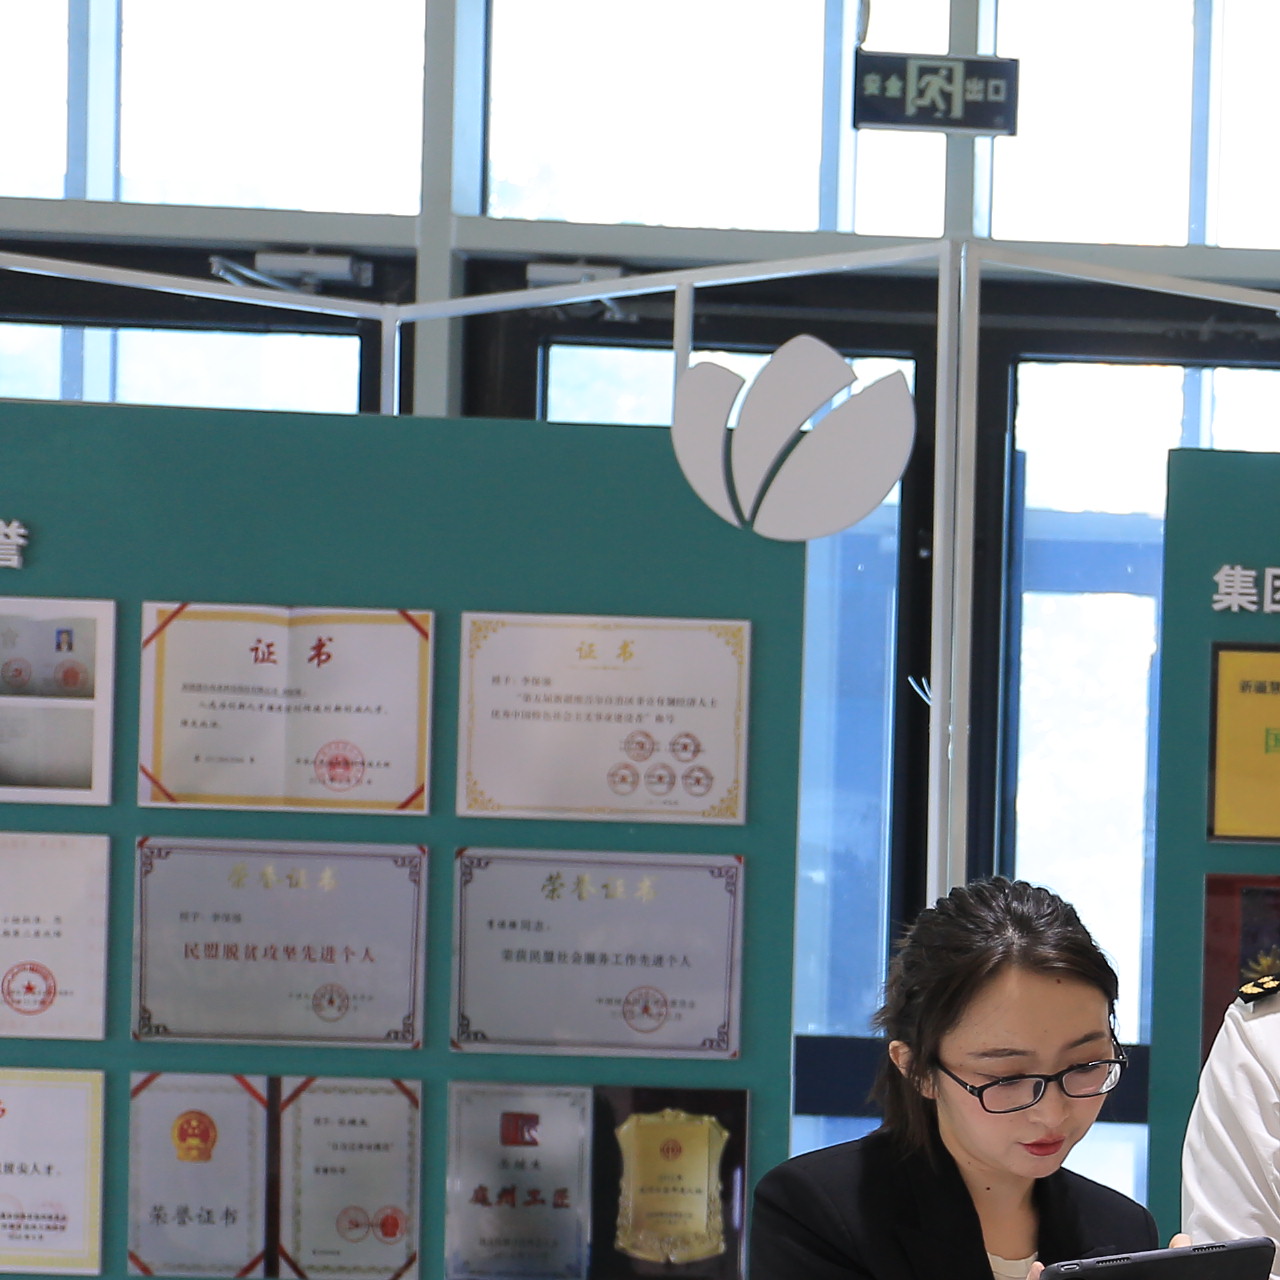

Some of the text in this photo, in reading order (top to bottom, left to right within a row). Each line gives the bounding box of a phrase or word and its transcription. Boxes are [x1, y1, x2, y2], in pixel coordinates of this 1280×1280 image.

[964, 76, 1007, 103] 出口
[250, 636, 334, 667] 证书
[575, 639, 636, 663] 证书
[541, 872, 658, 902] 荣誉证书
[183, 942, 376, 963] 民盟脱贫攻坚先进个人
[149, 1205, 238, 1226] 荣誉证书
